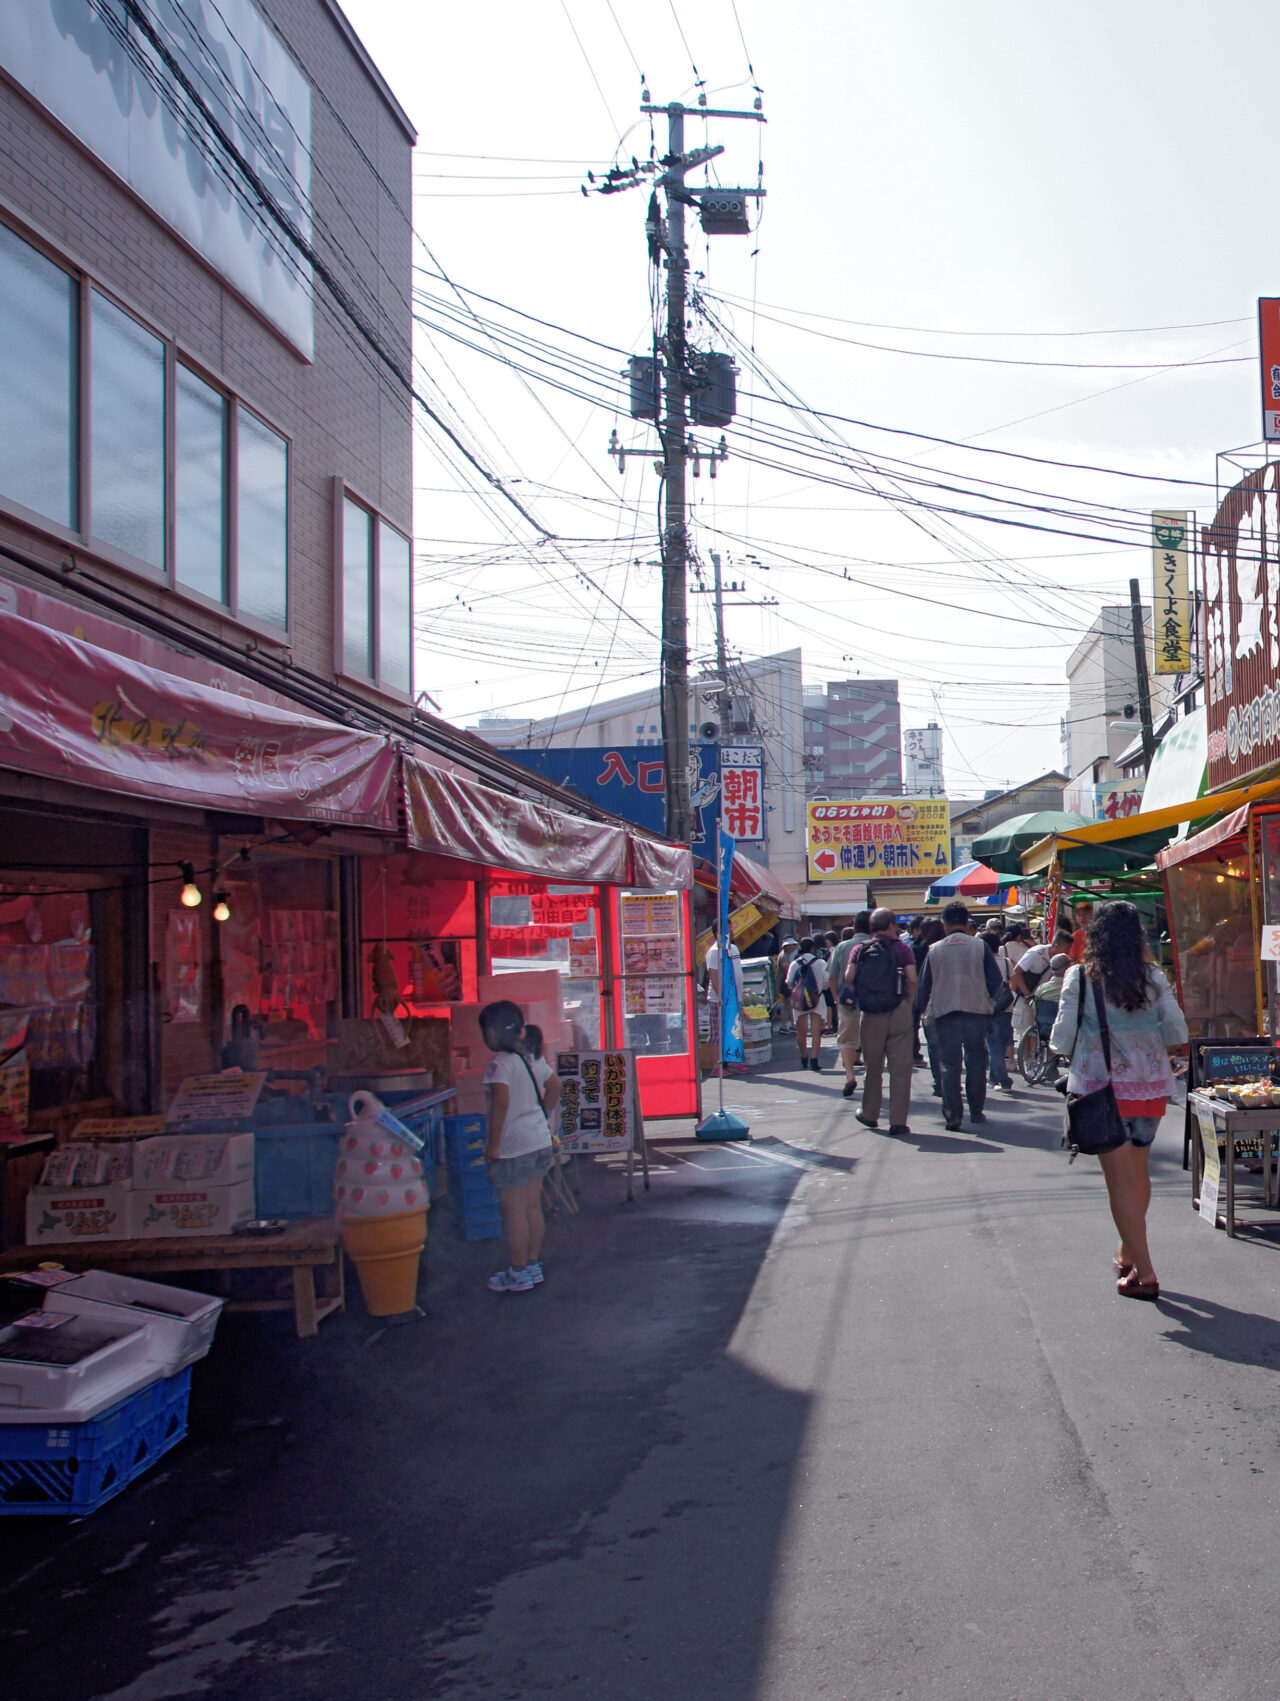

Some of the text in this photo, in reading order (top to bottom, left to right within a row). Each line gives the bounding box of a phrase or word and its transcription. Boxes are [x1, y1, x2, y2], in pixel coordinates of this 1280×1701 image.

[1163, 552, 1183, 662] きくよ食堂
[721, 751, 762, 765] はこだて
[723, 769, 761, 837] 朝市
[811, 822, 904, 843] ようこそ函館朝市へ
[840, 843, 948, 871] 仲通り・朝市ドーム
[581, 1060, 600, 1102] 釣って
[605, 1053, 626, 1137] いか釣り体験
[561, 1079, 580, 1134] 食べよう
